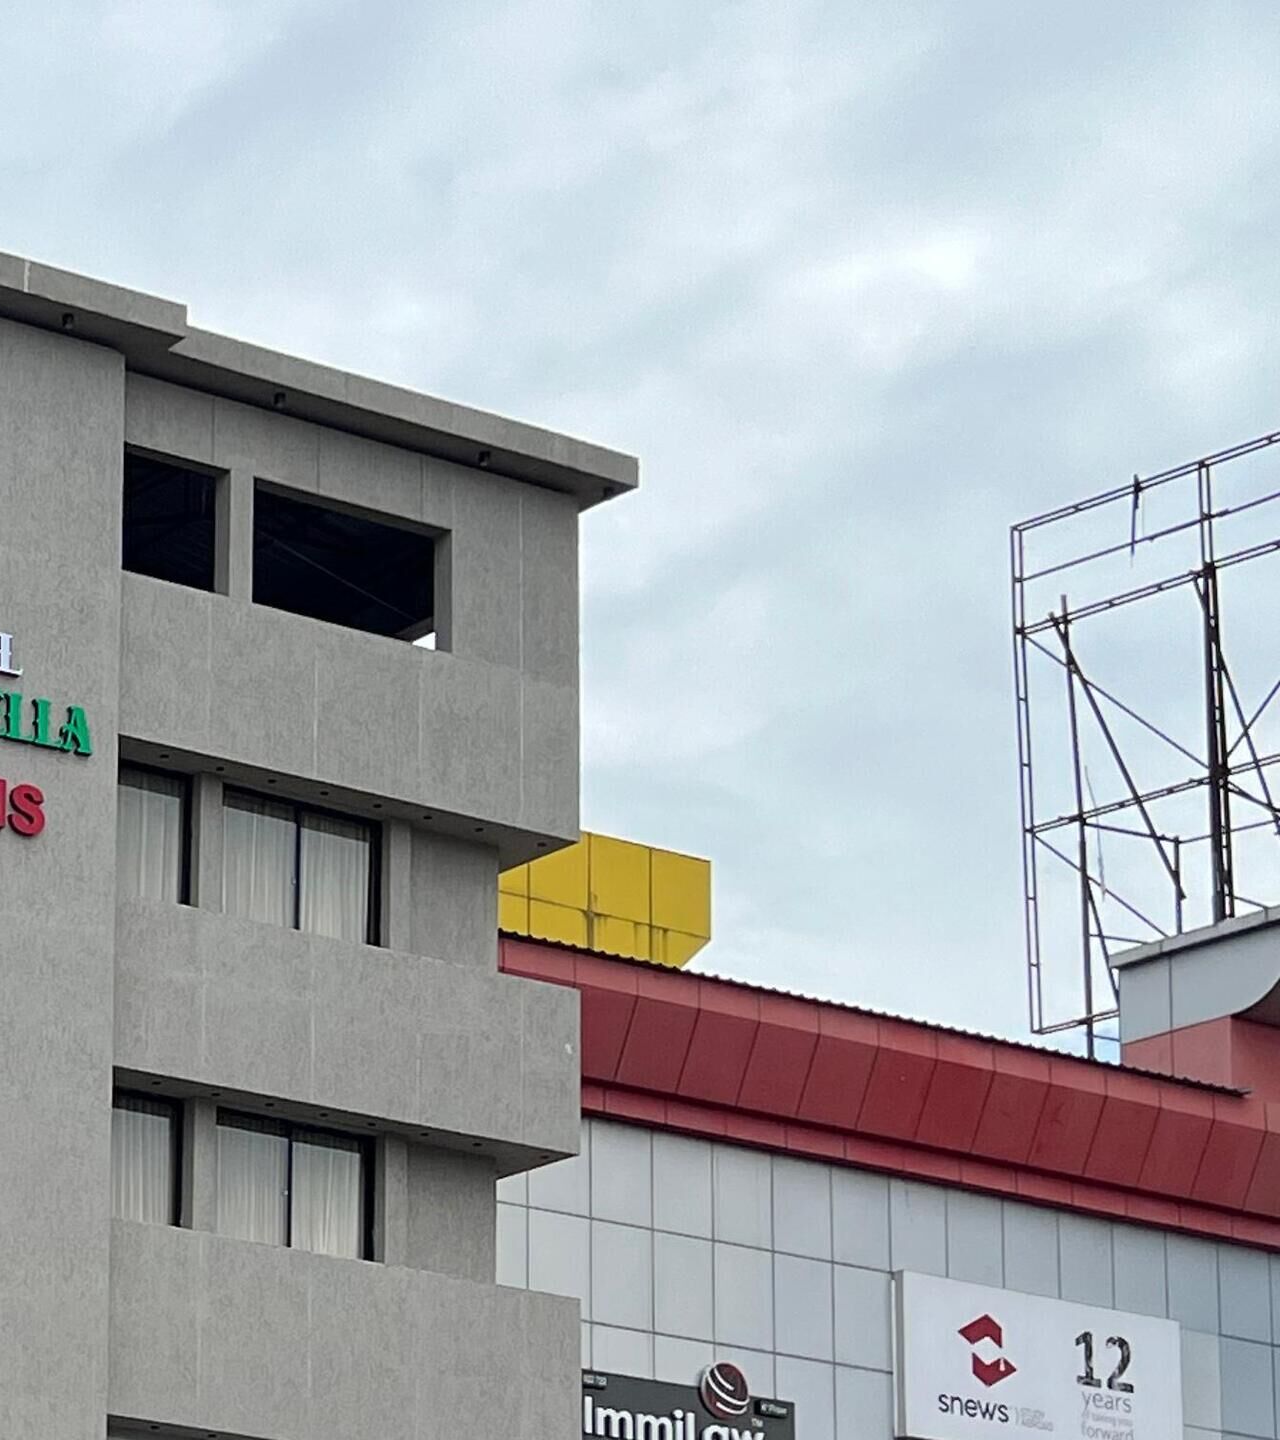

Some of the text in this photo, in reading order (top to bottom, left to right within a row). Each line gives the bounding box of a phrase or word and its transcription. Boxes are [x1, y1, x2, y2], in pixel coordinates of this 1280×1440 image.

[1075, 1331, 1134, 1393] 12
[938, 1393, 1009, 1423] snews
[1081, 1391, 1132, 1413] years
